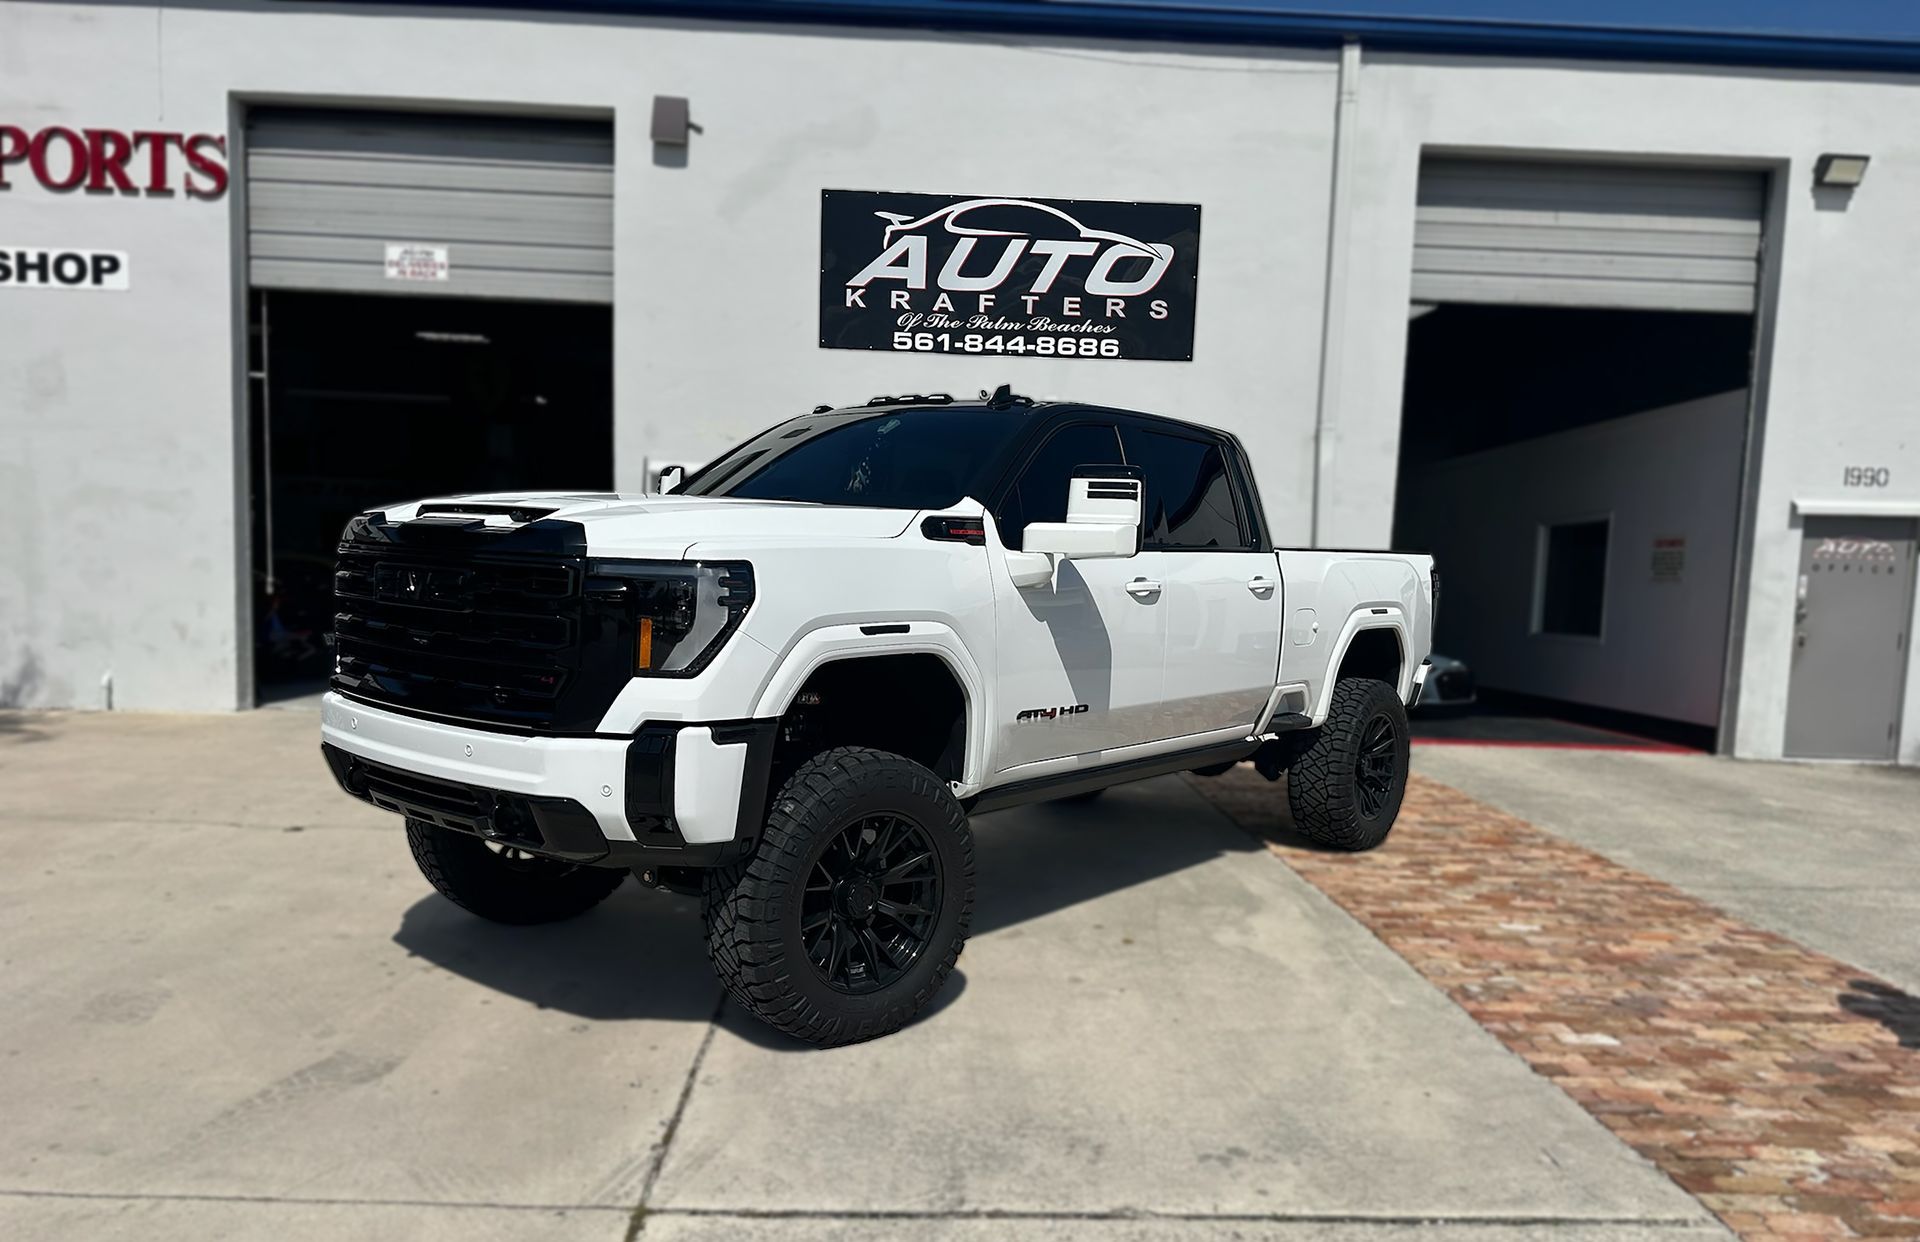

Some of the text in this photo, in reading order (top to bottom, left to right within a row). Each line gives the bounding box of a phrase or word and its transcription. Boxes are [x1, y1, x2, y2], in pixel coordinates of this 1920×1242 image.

[845, 234, 1175, 297] AUTO
[845, 288, 1169, 319] KRAFTERS
[897, 312, 1116, 334] Of The Palm Beaches
[893, 331, 1120, 357] 561-844-8686
[1843, 466, 1890, 487] 1990
[1059, 704, 1089, 715] HD
